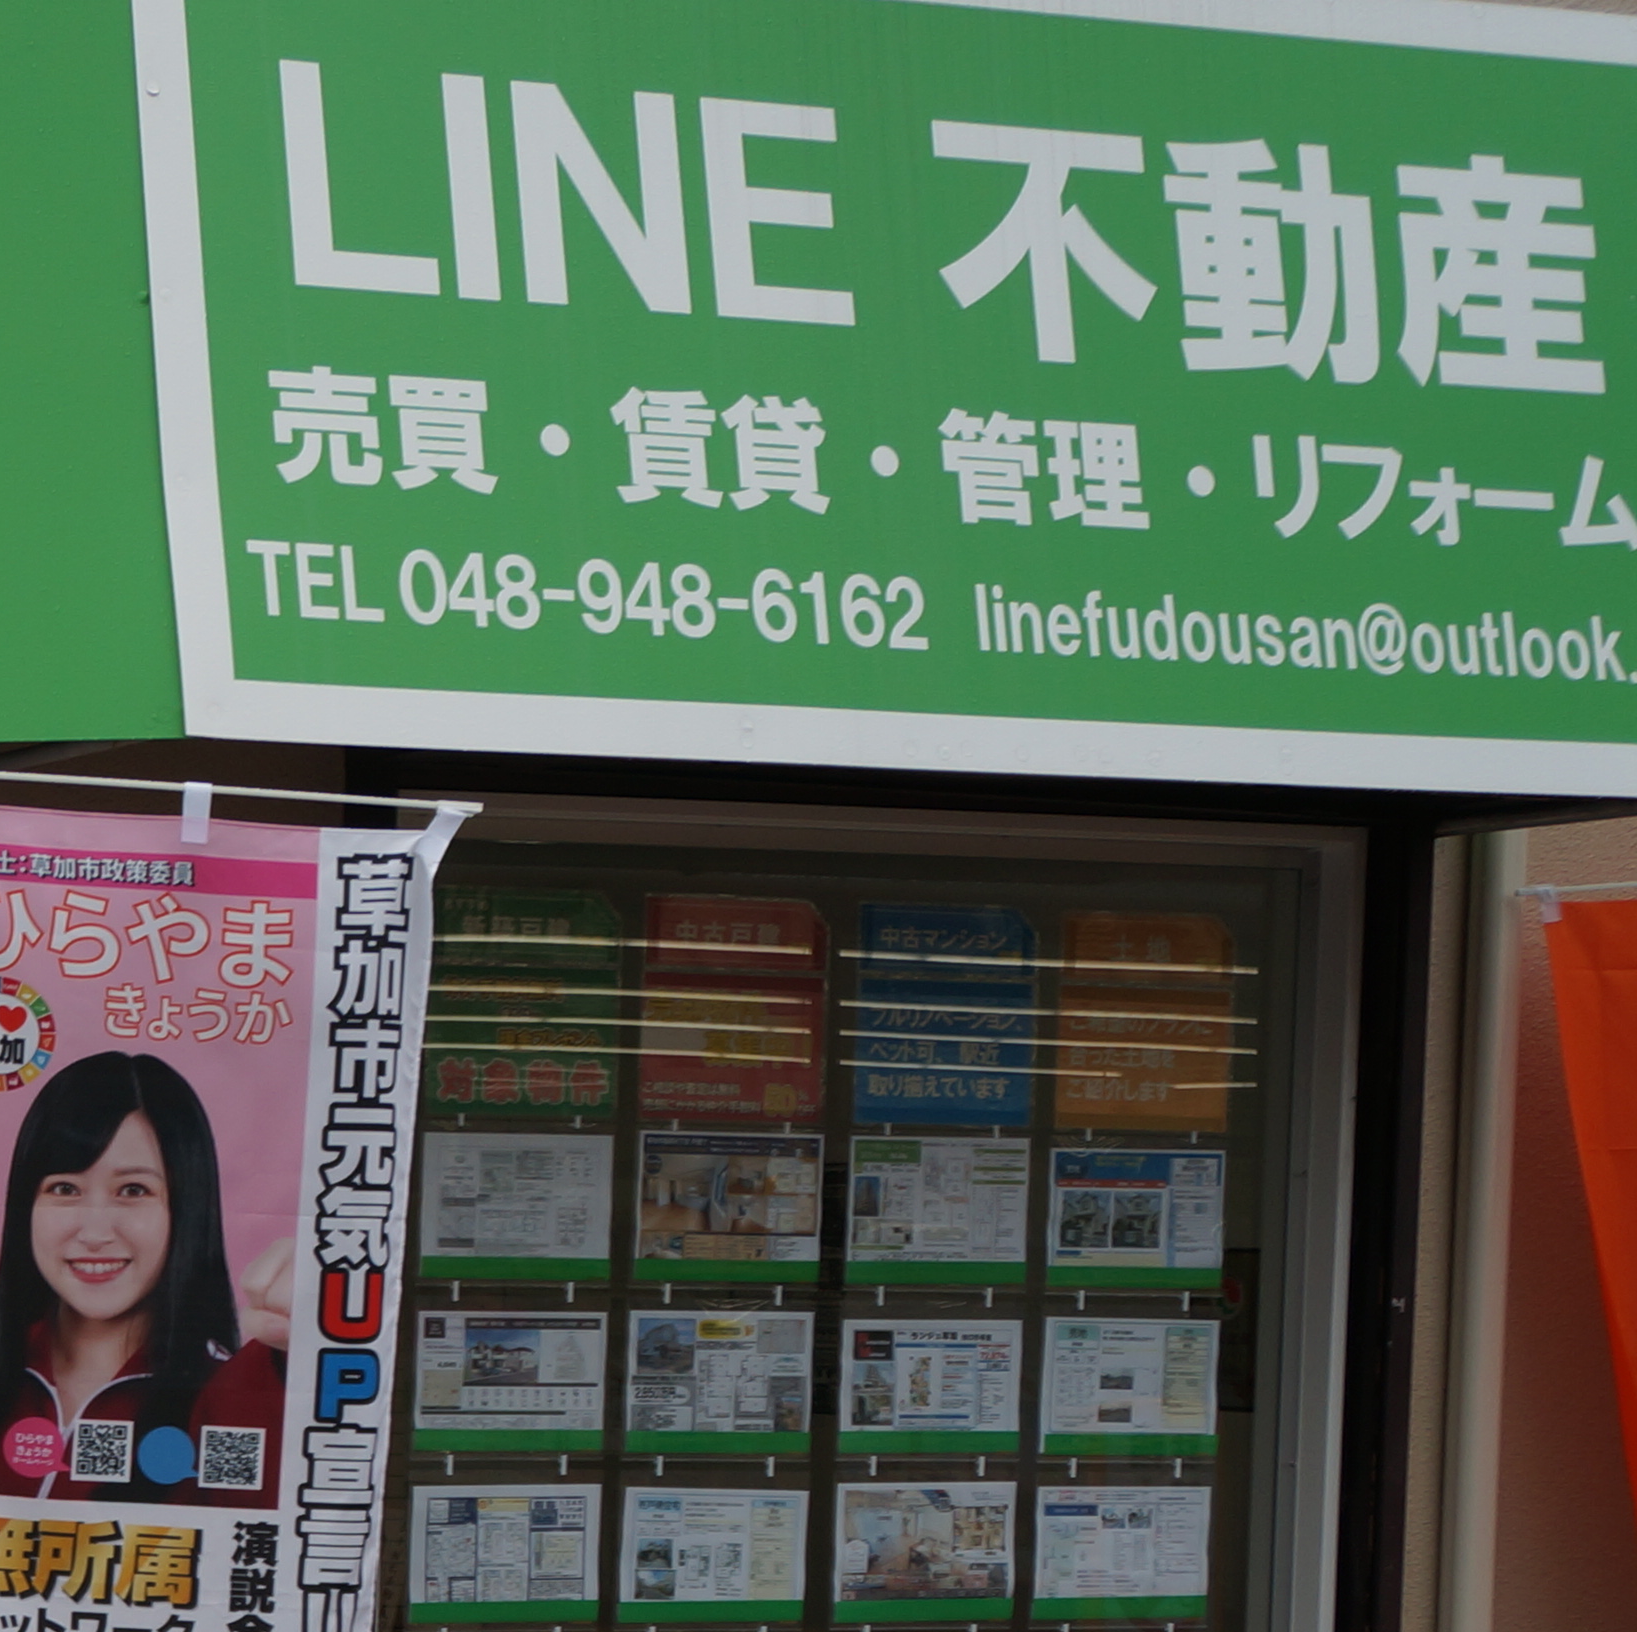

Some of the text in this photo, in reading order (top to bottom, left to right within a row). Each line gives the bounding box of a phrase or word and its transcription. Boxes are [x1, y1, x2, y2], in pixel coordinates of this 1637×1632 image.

[279, 58, 1606, 395] LINE 不動産
[267, 365, 1637, 551] 売買・賃貸・管理・リフォーム
[245, 539, 385, 623] TEL
[398, 548, 930, 651] 048-948-6162
[880, 925, 1008, 951] 中古マンション
[104, 982, 294, 1047] きょうか
[867, 1073, 1010, 1100] 取り揃えています
